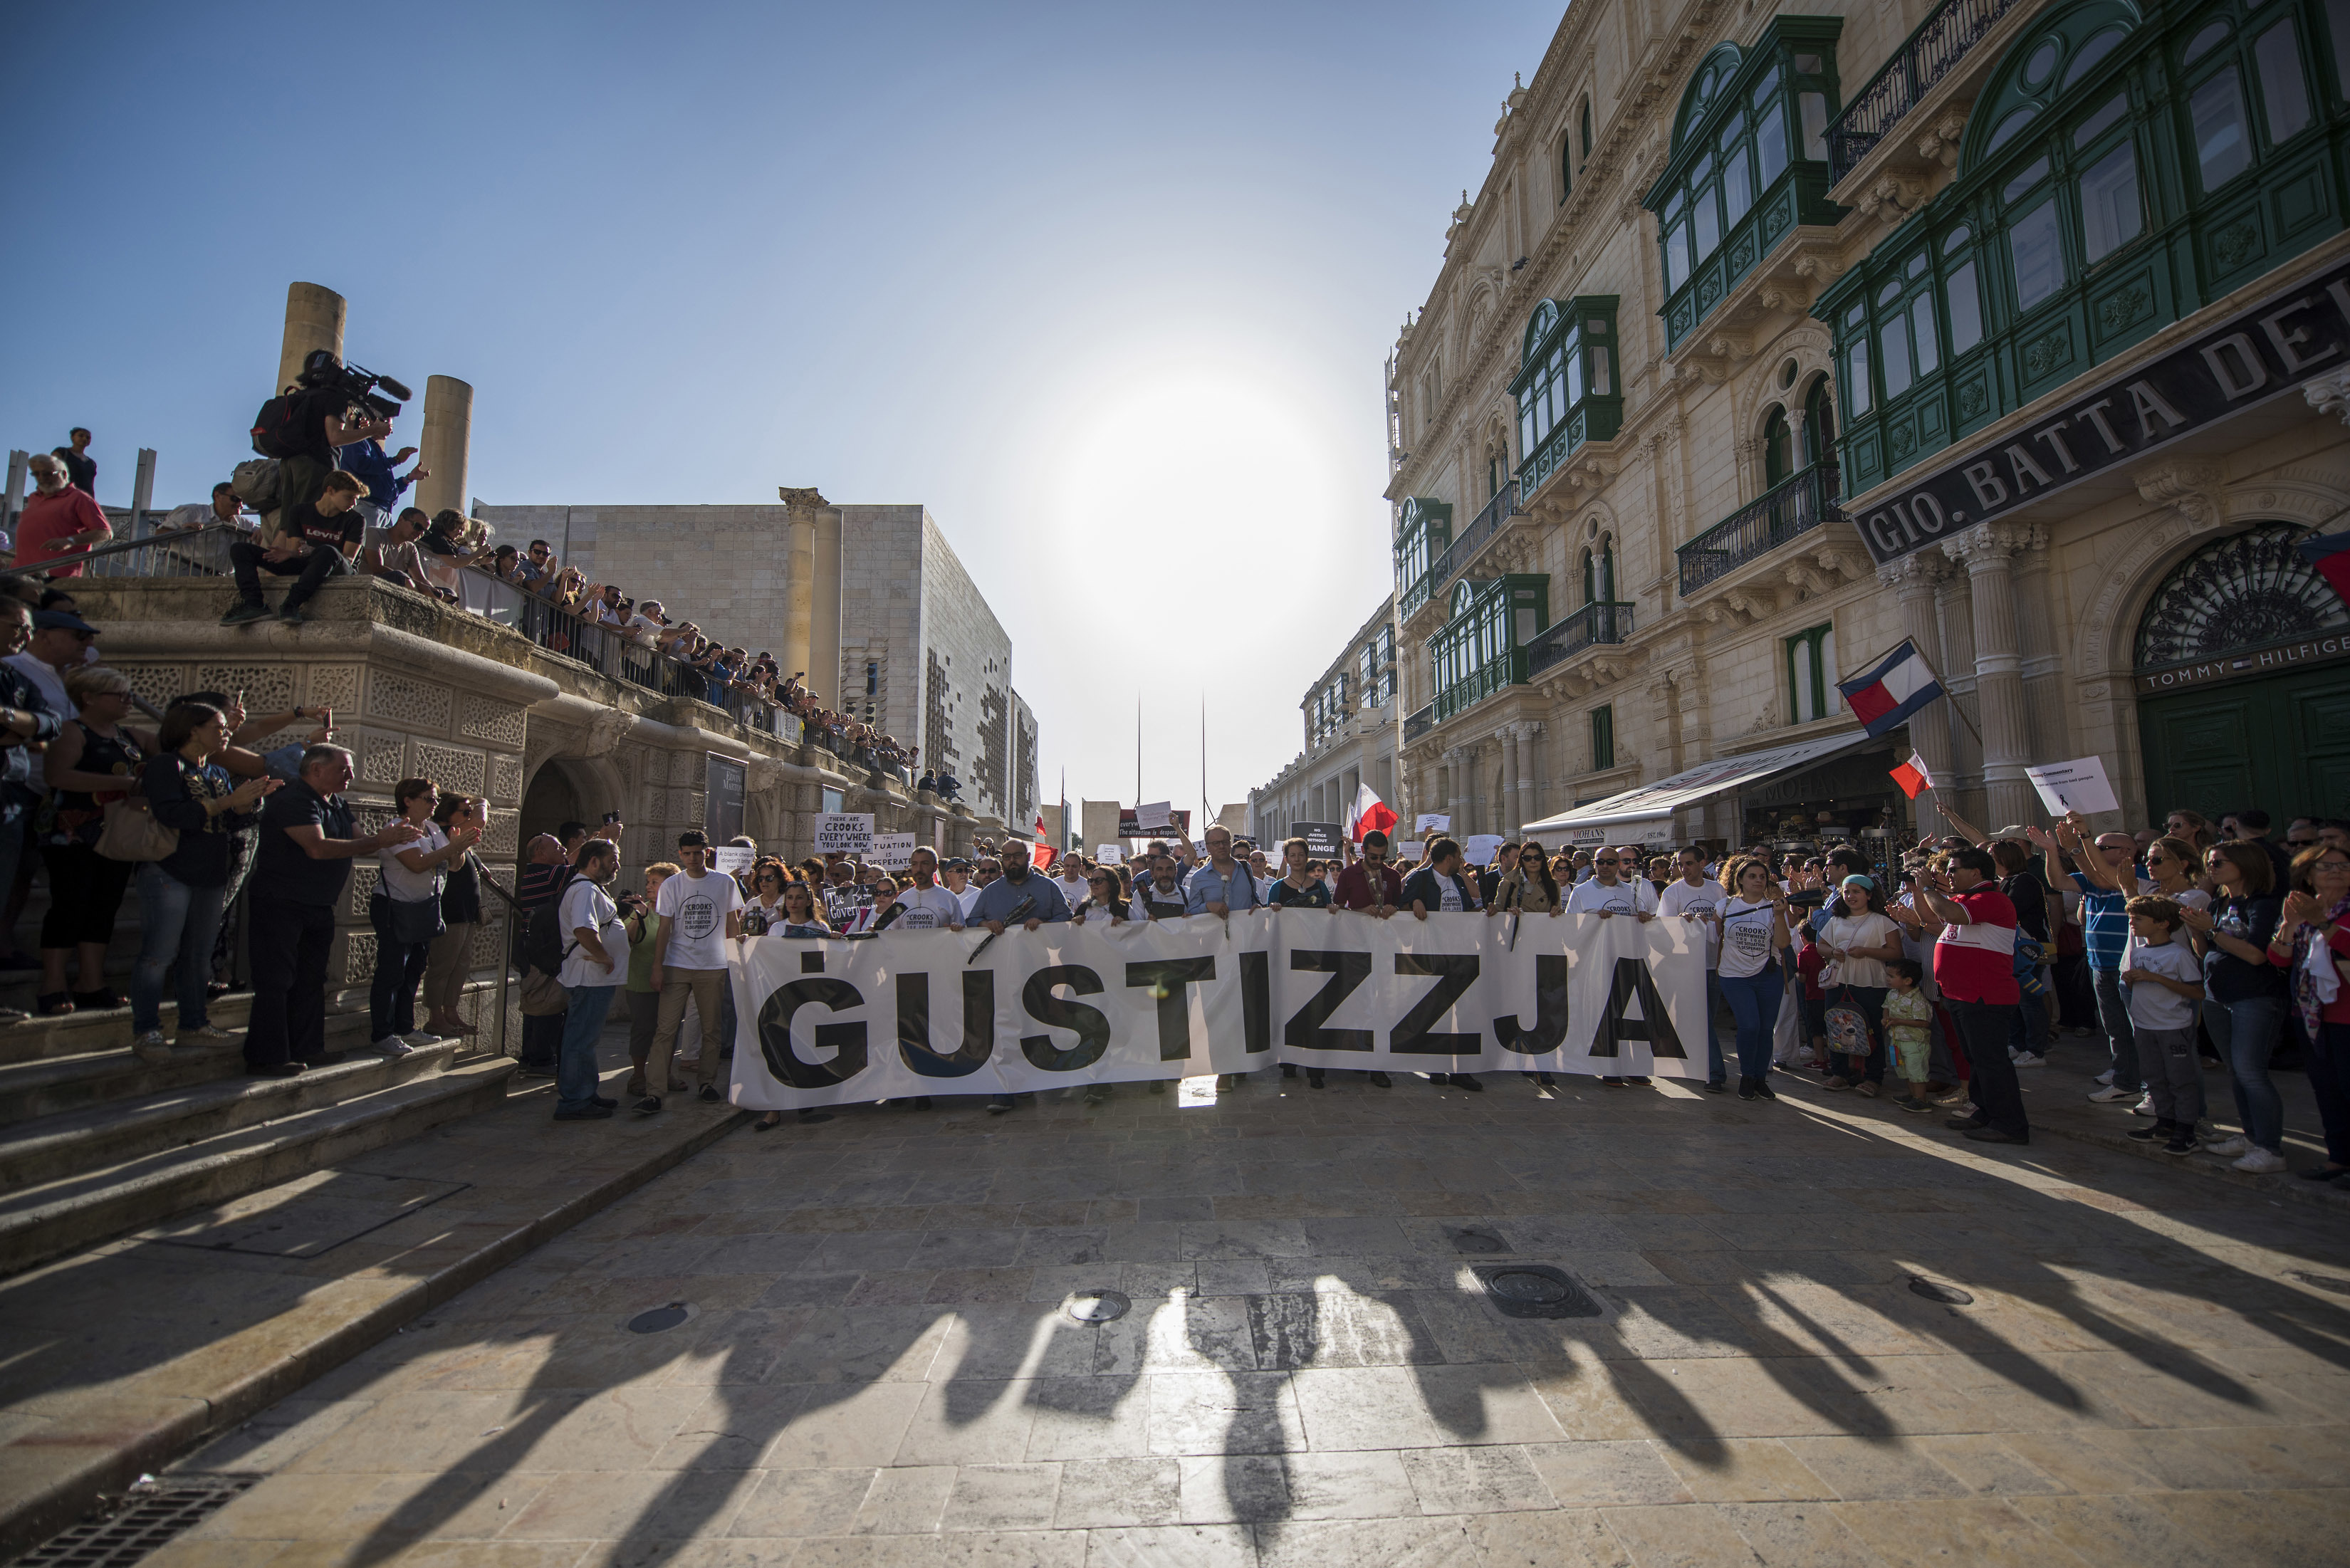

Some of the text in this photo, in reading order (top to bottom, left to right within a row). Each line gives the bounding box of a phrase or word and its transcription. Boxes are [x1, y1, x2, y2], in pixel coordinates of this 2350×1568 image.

[1869, 491, 1965, 553] GIO.
[1962, 380, 2186, 511] BATTA
[2147, 662, 2225, 688] TOMMY
[2043, 768, 2073, 777] Commentary
[825, 823, 865, 832] CROOKS
[820, 832, 872, 841] EVERYWHERE
[1572, 828, 1604, 839] MOHANS
[827, 891, 845, 906] The
[1735, 926, 1766, 935] "CROOKS
[758, 949, 1688, 1089] ĠUSTIZZJA
